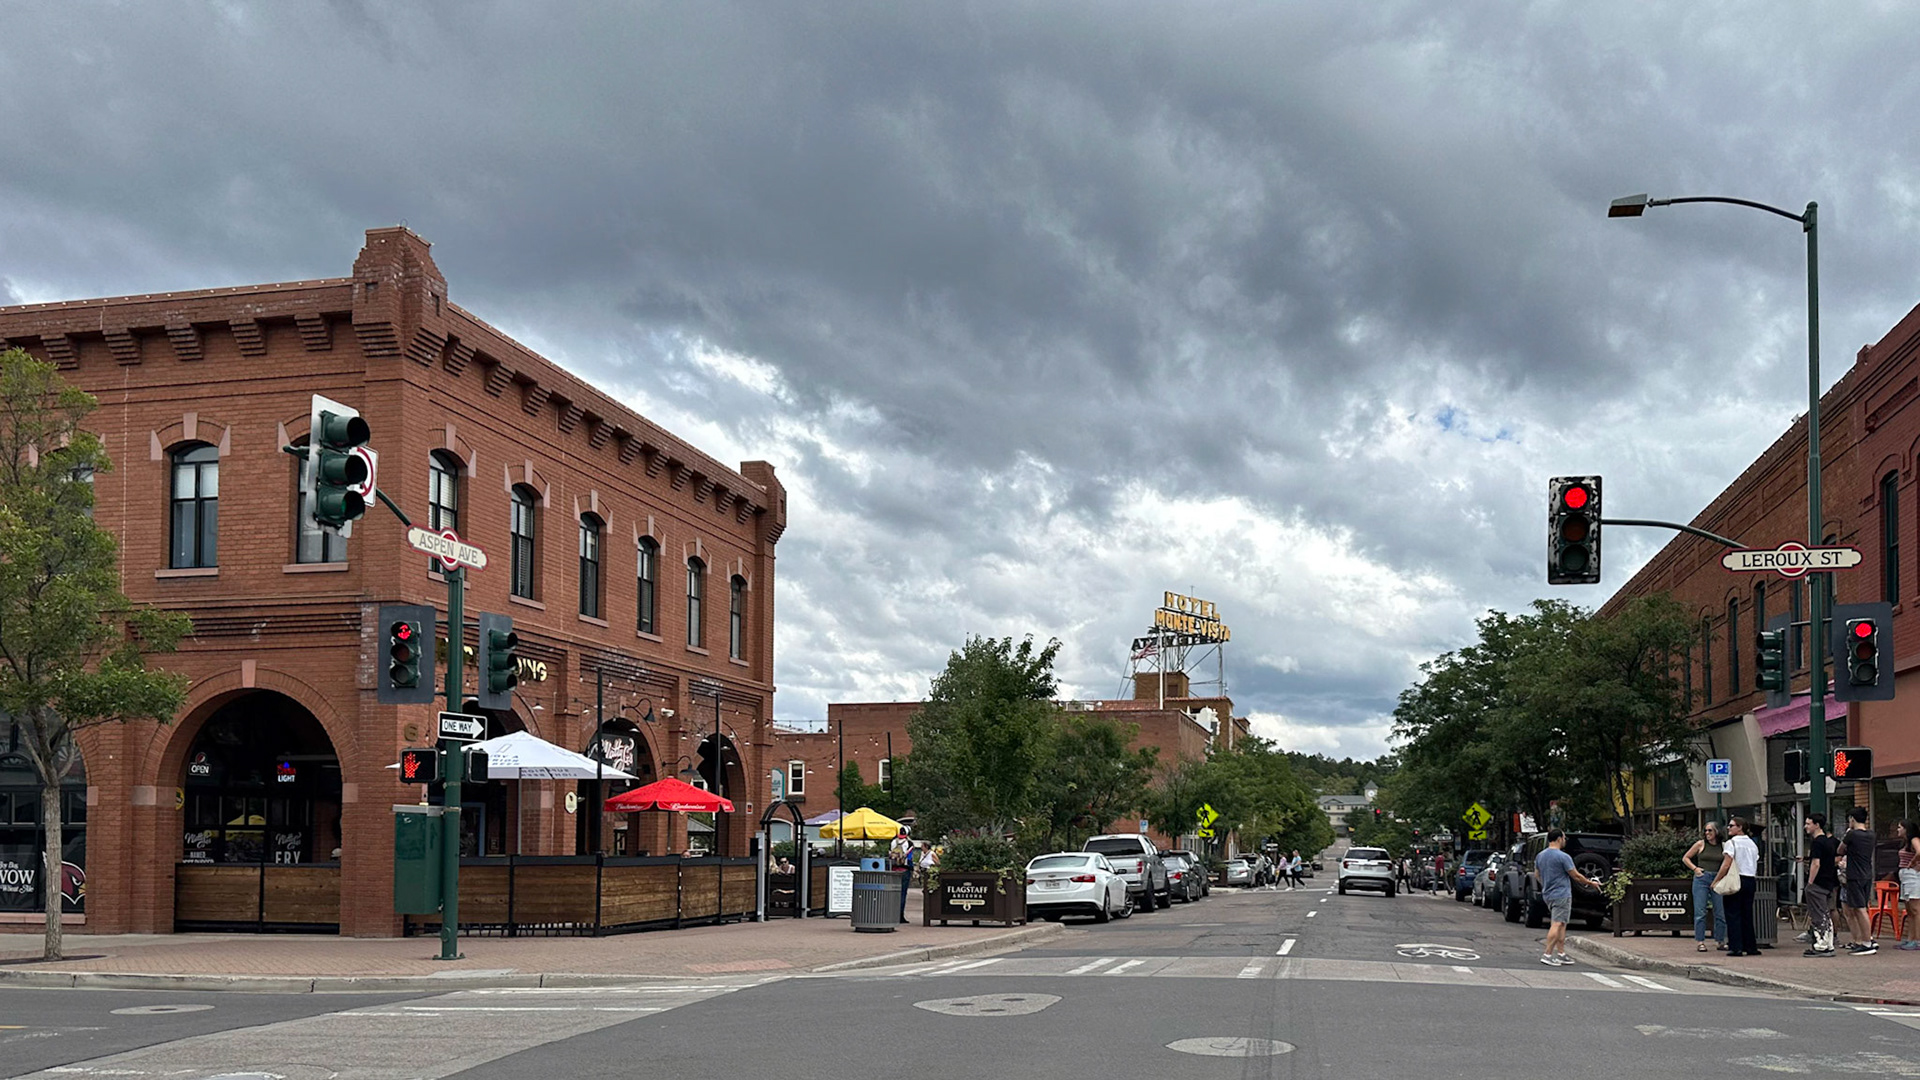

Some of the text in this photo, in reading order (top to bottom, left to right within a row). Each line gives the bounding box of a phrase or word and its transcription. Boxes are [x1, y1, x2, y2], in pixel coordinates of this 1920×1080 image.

[419, 533, 478, 564] ASPEN AVE
[1742, 551, 1842, 567] LEROUX ST
[1164, 591, 1220, 619] HOTEL
[1155, 609, 1230, 641] MONTE VISTA
[444, 721, 472, 732] ONE WAY
[191, 764, 209, 774] OPEN
[1715, 763, 1724, 773] P
[671, 802, 706, 810] Budweiser
[275, 851, 301, 864] FRY
[947, 885, 988, 894] FLAGSTAFF
[1640, 893, 1688, 901] FLAGSTAFF
